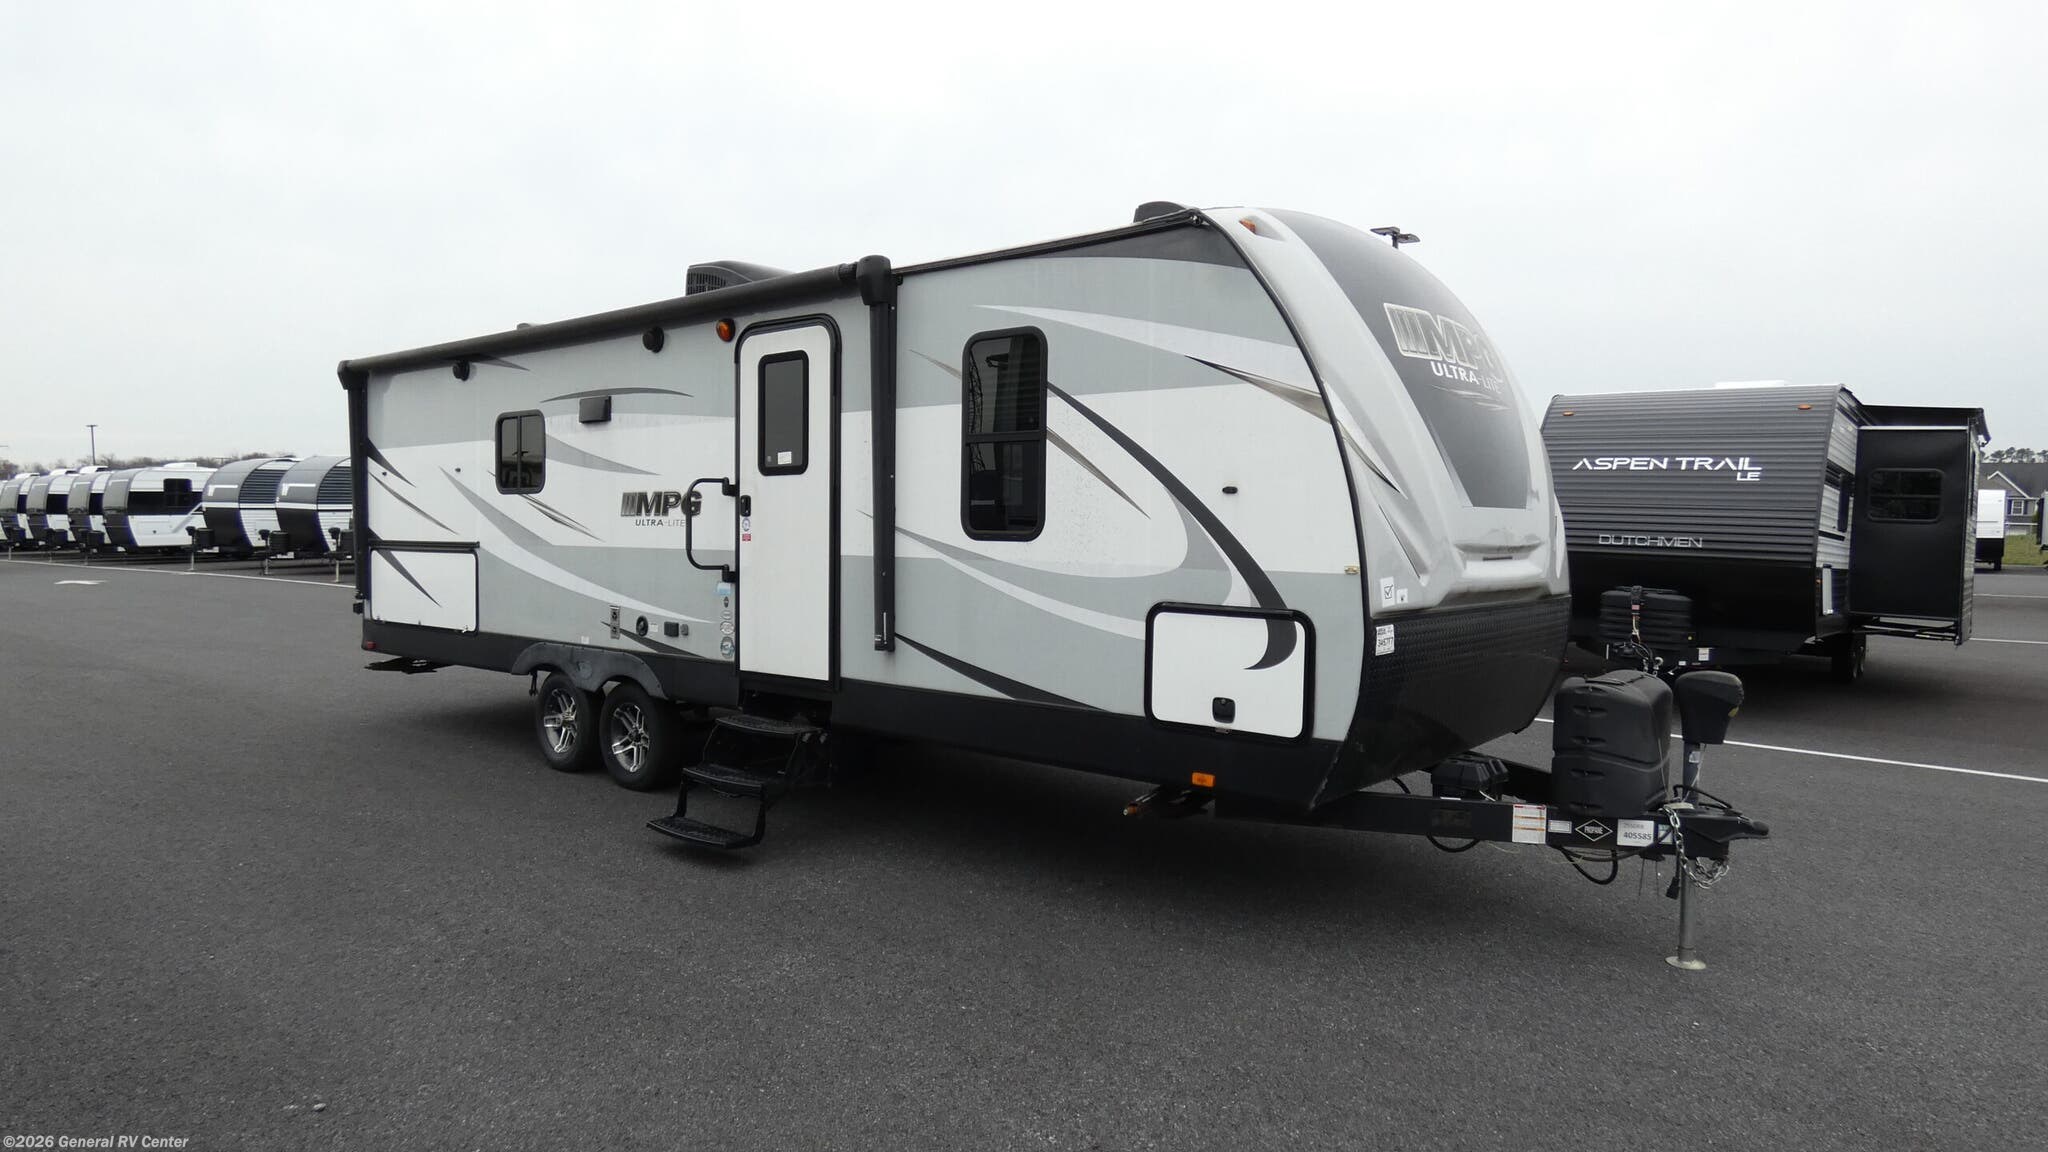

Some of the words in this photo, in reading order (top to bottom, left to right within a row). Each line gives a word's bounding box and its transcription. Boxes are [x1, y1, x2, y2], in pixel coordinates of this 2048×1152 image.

[1572, 457, 1669, 471] ASPEN
[1675, 457, 1763, 471] TRAIL
[1736, 471, 1762, 482] LE
[635, 490, 703, 517] MPG
[635, 519, 686, 527] ULTRA-LITE
[1598, 534, 1703, 548] DUTCHMEN
[1623, 831, 1653, 841] 405585
